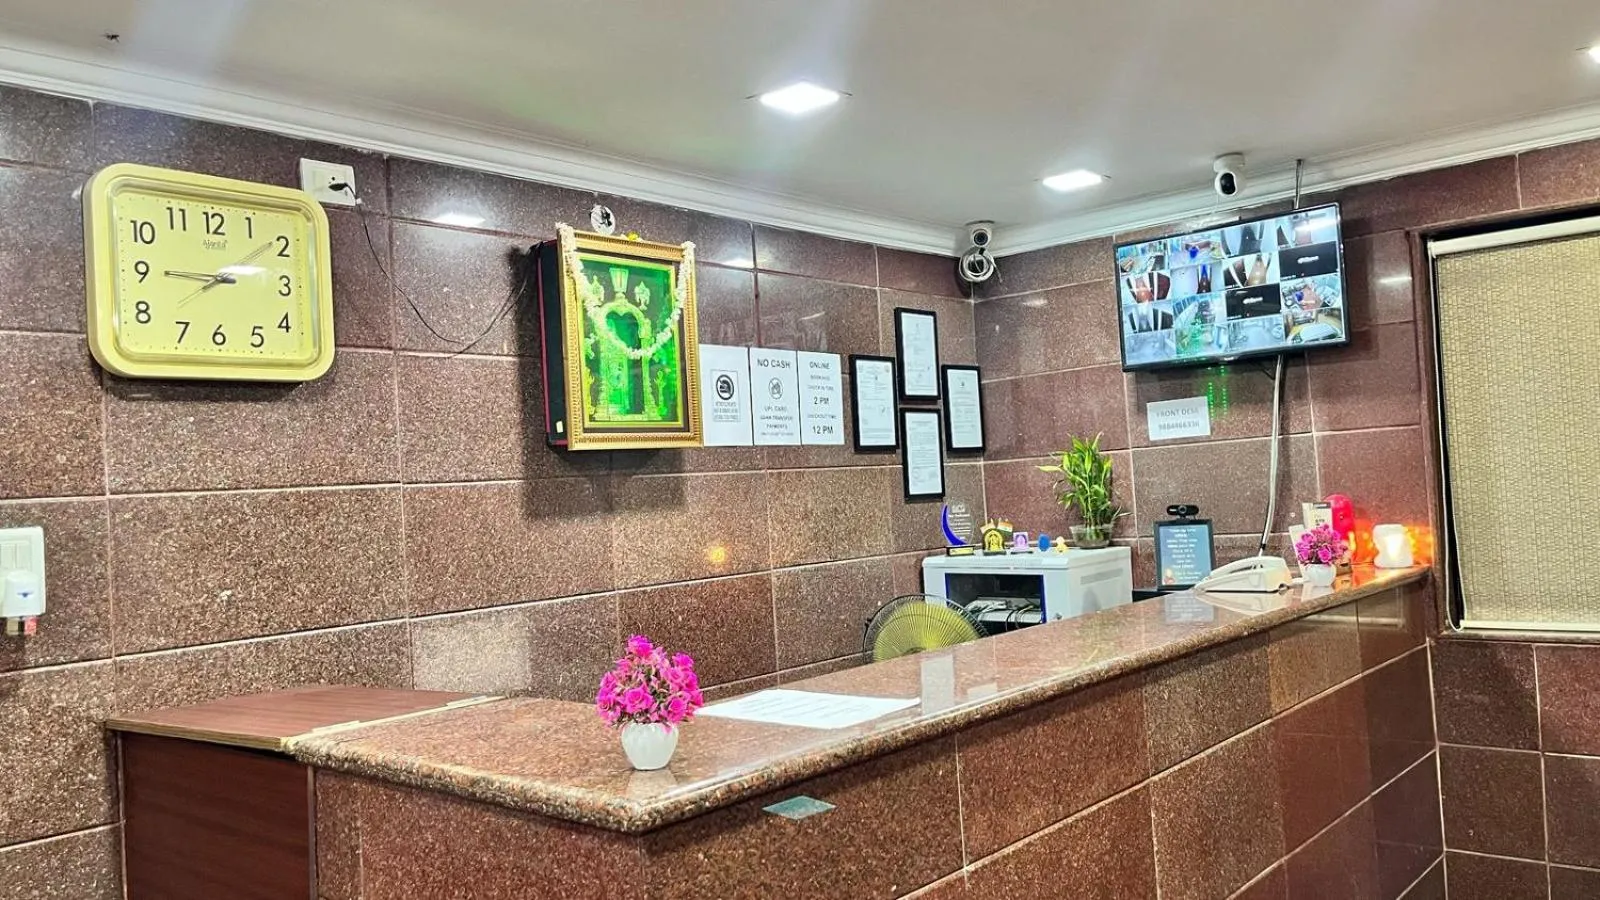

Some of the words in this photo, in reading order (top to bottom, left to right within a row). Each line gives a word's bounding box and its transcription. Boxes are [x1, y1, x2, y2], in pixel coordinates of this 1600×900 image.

[166, 207, 186, 231] 11
[202, 211, 226, 236] 12
[245, 216, 252, 239] 1
[130, 220, 155, 244] 10
[276, 235, 290, 257] 2
[134, 260, 150, 283] 9
[278, 275, 291, 297] 3
[135, 300, 151, 324] 8
[277, 312, 292, 333] 4
[175, 321, 190, 344] 7
[212, 324, 226, 346] 6
[250, 326, 265, 348] 5
[757, 358, 769, 368] NO
[771, 360, 791, 369] CASH
[809, 361, 831, 370] ONLINE
[814, 396, 818, 405] 2
[820, 397, 830, 405] PM
[1156, 408, 1180, 418] FRONT
[812, 425, 821, 434] 12
[823, 425, 834, 435] PM
